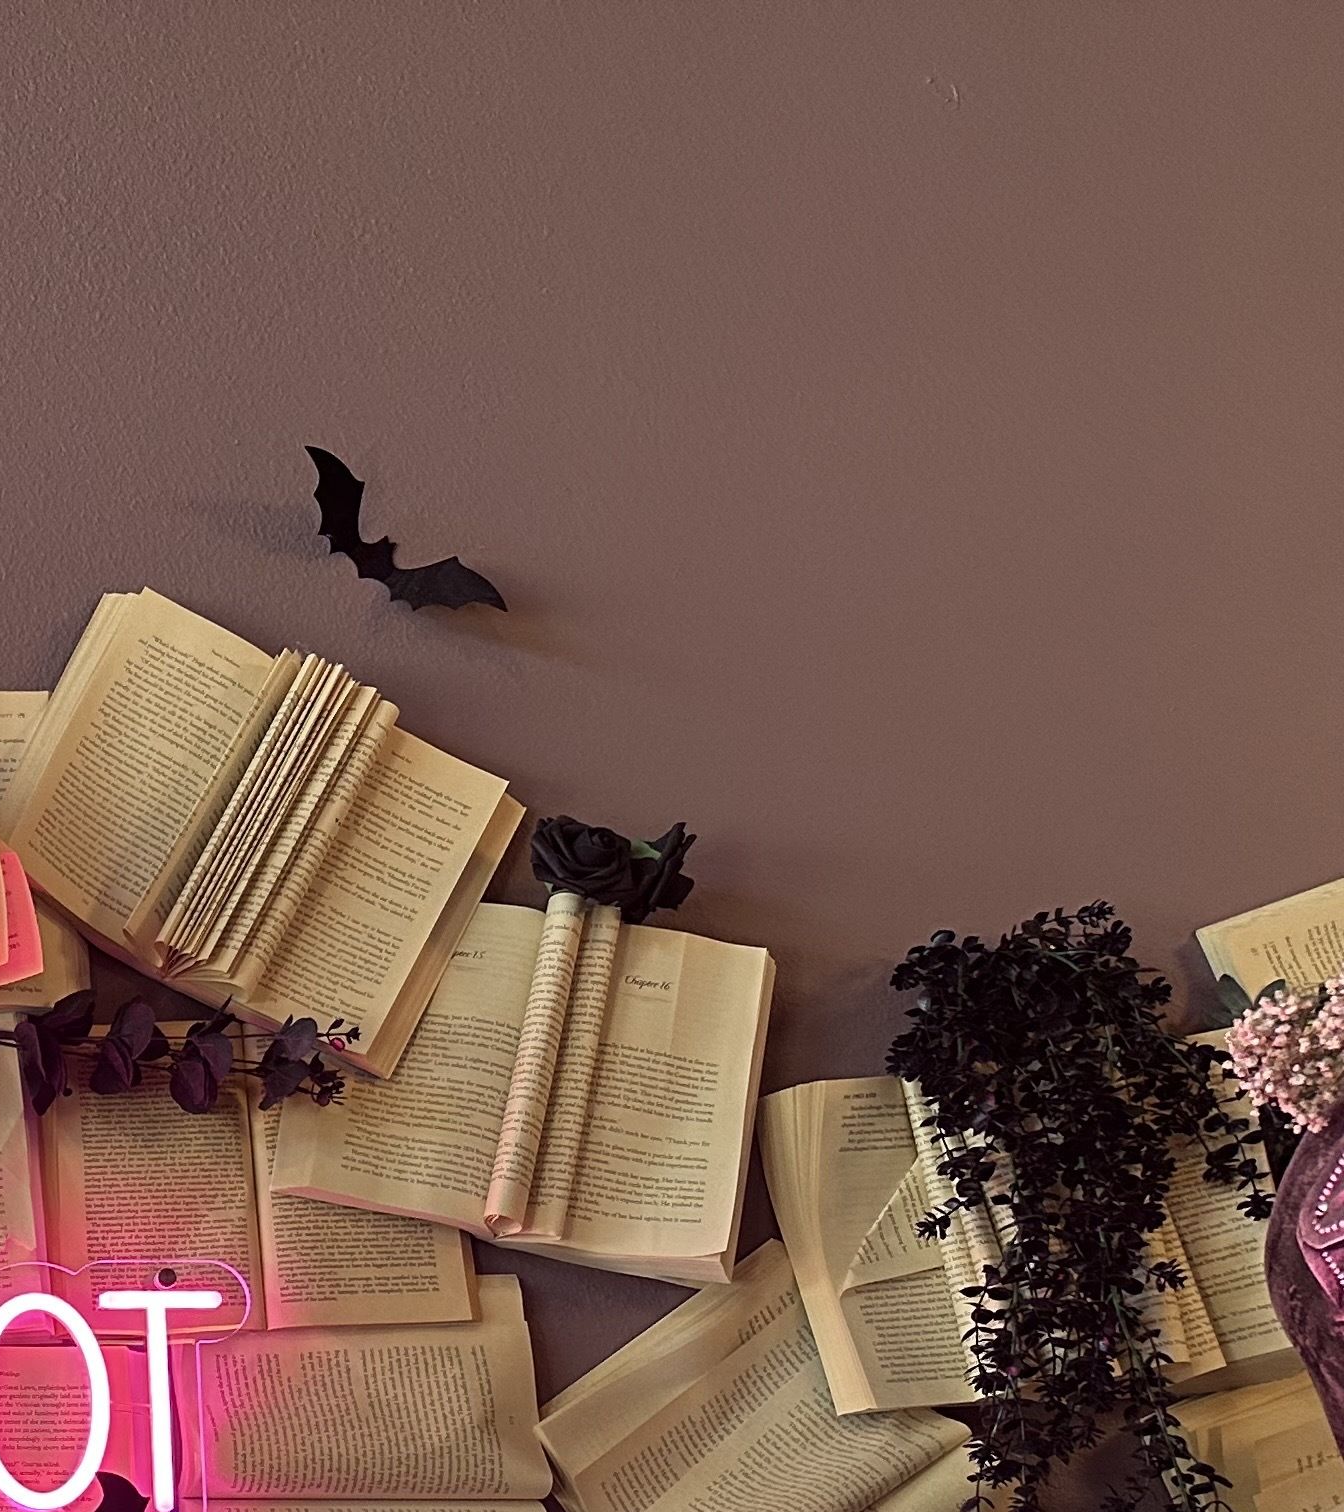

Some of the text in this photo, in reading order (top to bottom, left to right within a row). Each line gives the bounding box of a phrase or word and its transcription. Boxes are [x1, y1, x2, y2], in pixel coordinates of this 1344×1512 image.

[472, 950, 486, 959] 15
[624, 974, 674, 991] Chapter 16
